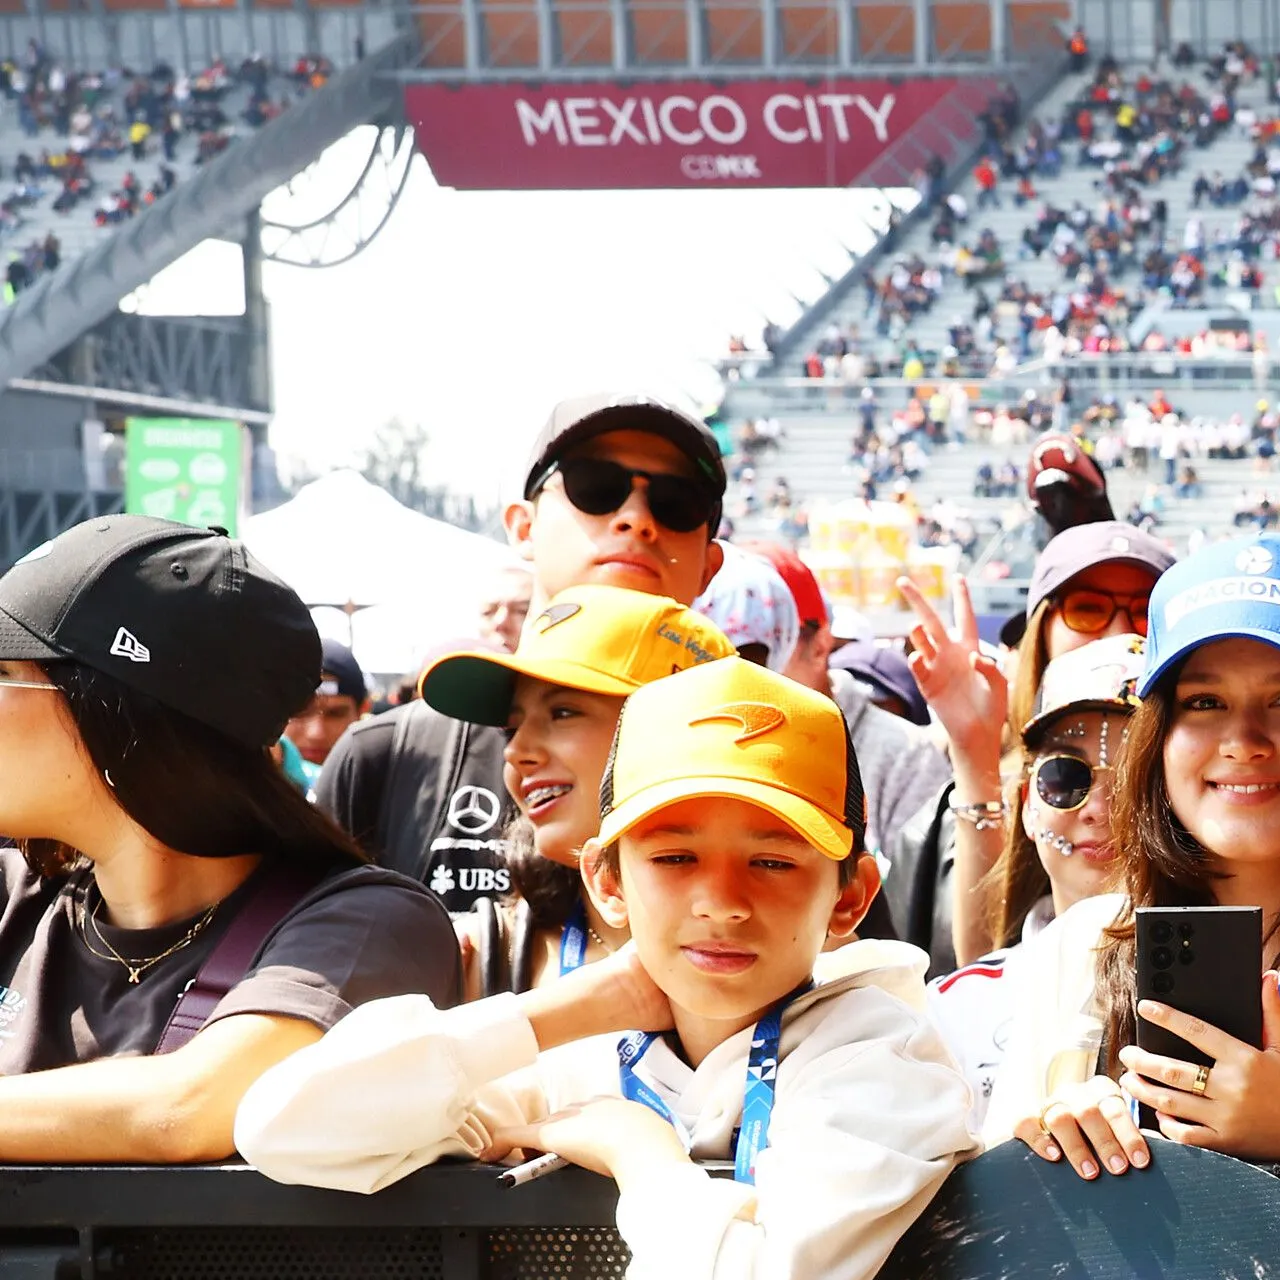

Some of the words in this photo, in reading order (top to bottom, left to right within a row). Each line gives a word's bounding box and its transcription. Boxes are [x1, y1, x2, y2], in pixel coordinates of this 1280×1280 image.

[515, 95, 748, 146] MEXICO
[763, 94, 896, 144] CITY
[680, 155, 762, 179] CDMX
[458, 868, 511, 891] UBS
